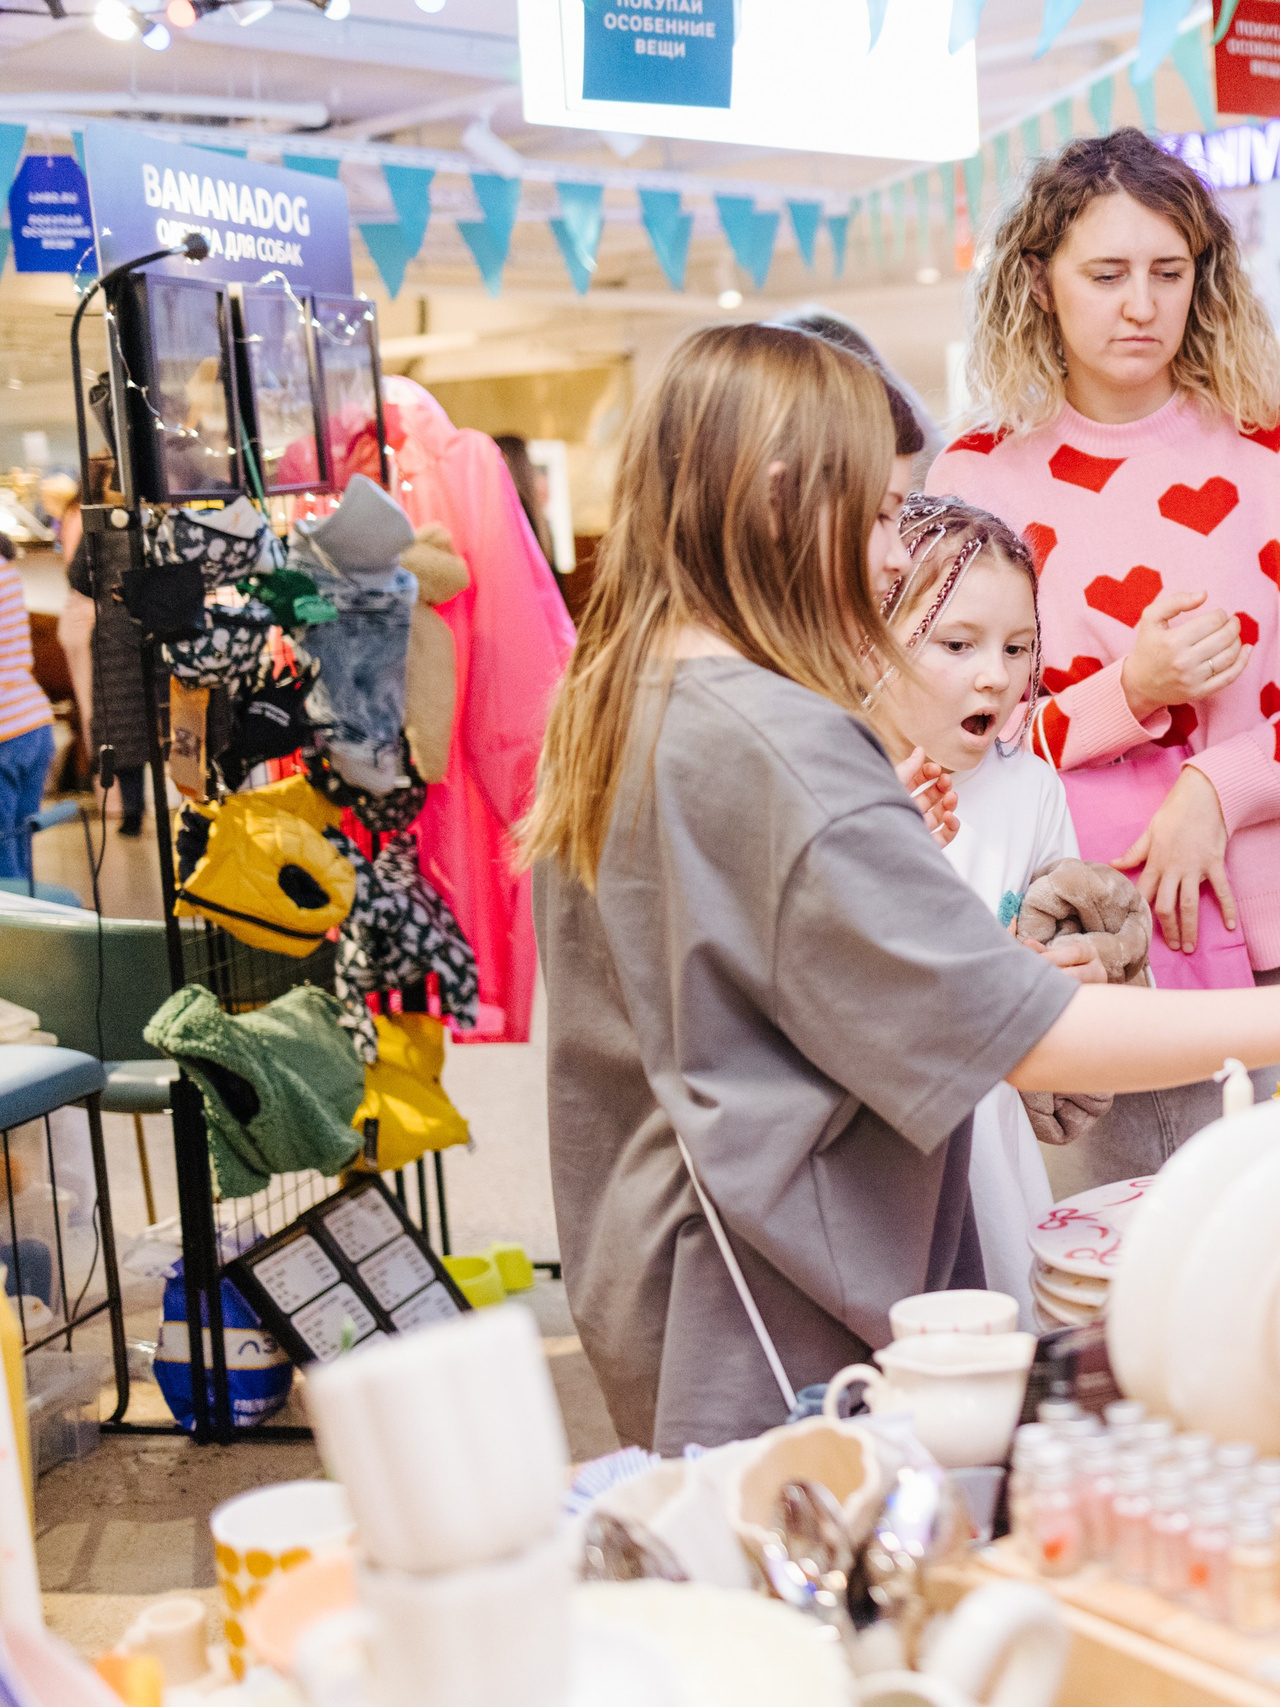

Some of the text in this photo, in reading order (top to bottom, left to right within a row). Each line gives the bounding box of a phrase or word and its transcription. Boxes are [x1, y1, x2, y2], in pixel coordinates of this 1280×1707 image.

[603, 12, 717, 38] ОСОБЕННЫЕ
[634, 38, 687, 61] ВЕЩИ
[142, 163, 311, 237] BANANADOG
[156, 217, 304, 267] ОДЕА ДЛЯ СОБАК
